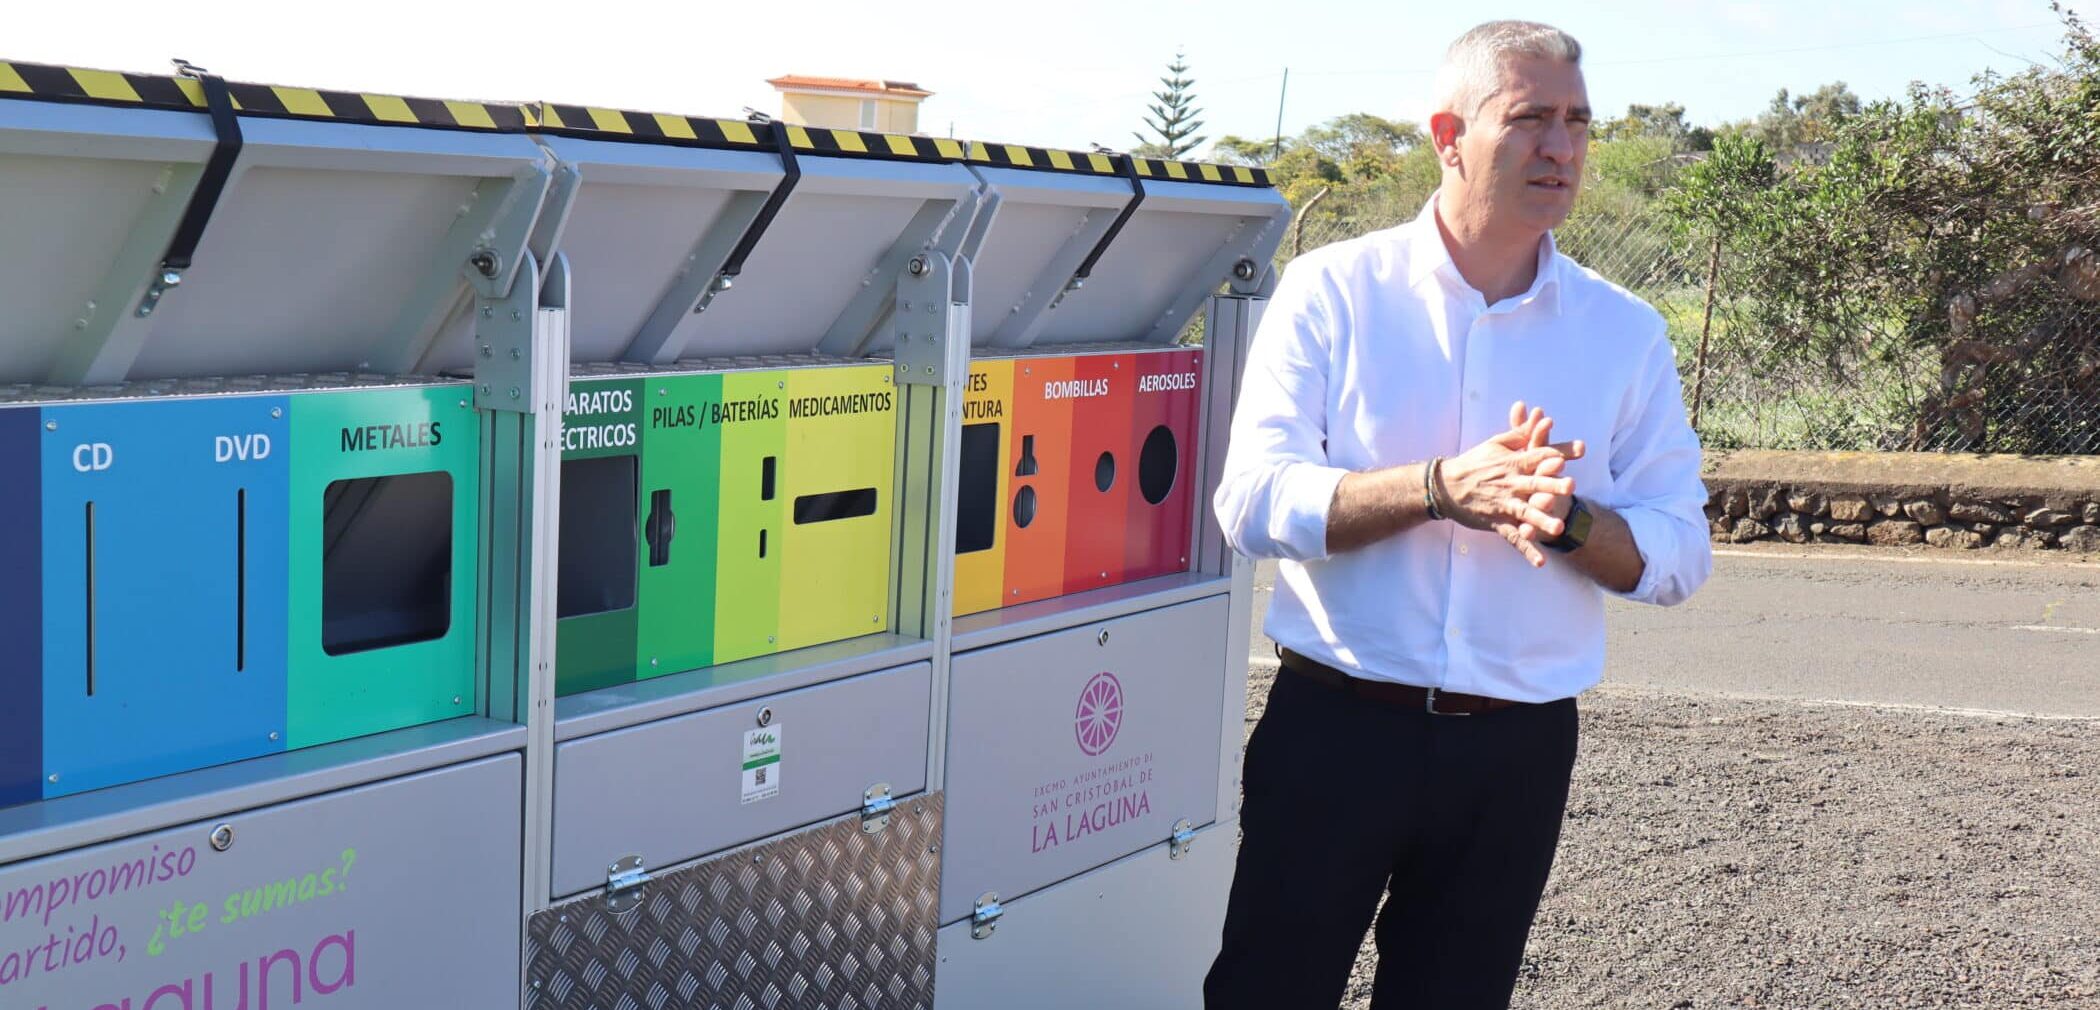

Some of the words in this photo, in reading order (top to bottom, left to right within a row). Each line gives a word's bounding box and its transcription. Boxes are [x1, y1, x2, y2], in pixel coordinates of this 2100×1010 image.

[1045, 378, 1108, 400] BOMBILLAS
[1138, 373, 1196, 393] AEROSOLES
[653, 403, 696, 429] PILAS
[699, 401, 708, 430] /
[711, 394, 779, 424] BATERÍAS
[789, 392, 892, 419] MEDICAMENTOS
[215, 433, 271, 463] DVD
[341, 421, 442, 452] METALES
[72, 442, 114, 472] CD
[1033, 799, 1059, 820] SAN
[1140, 768, 1153, 785] DE
[1032, 821, 1058, 854] LA
[1066, 791, 1151, 842] LAGUNA
[0, 844, 196, 927] mpromiso
[147, 900, 209, 956] ¿te
[220, 847, 357, 925] sumas?
